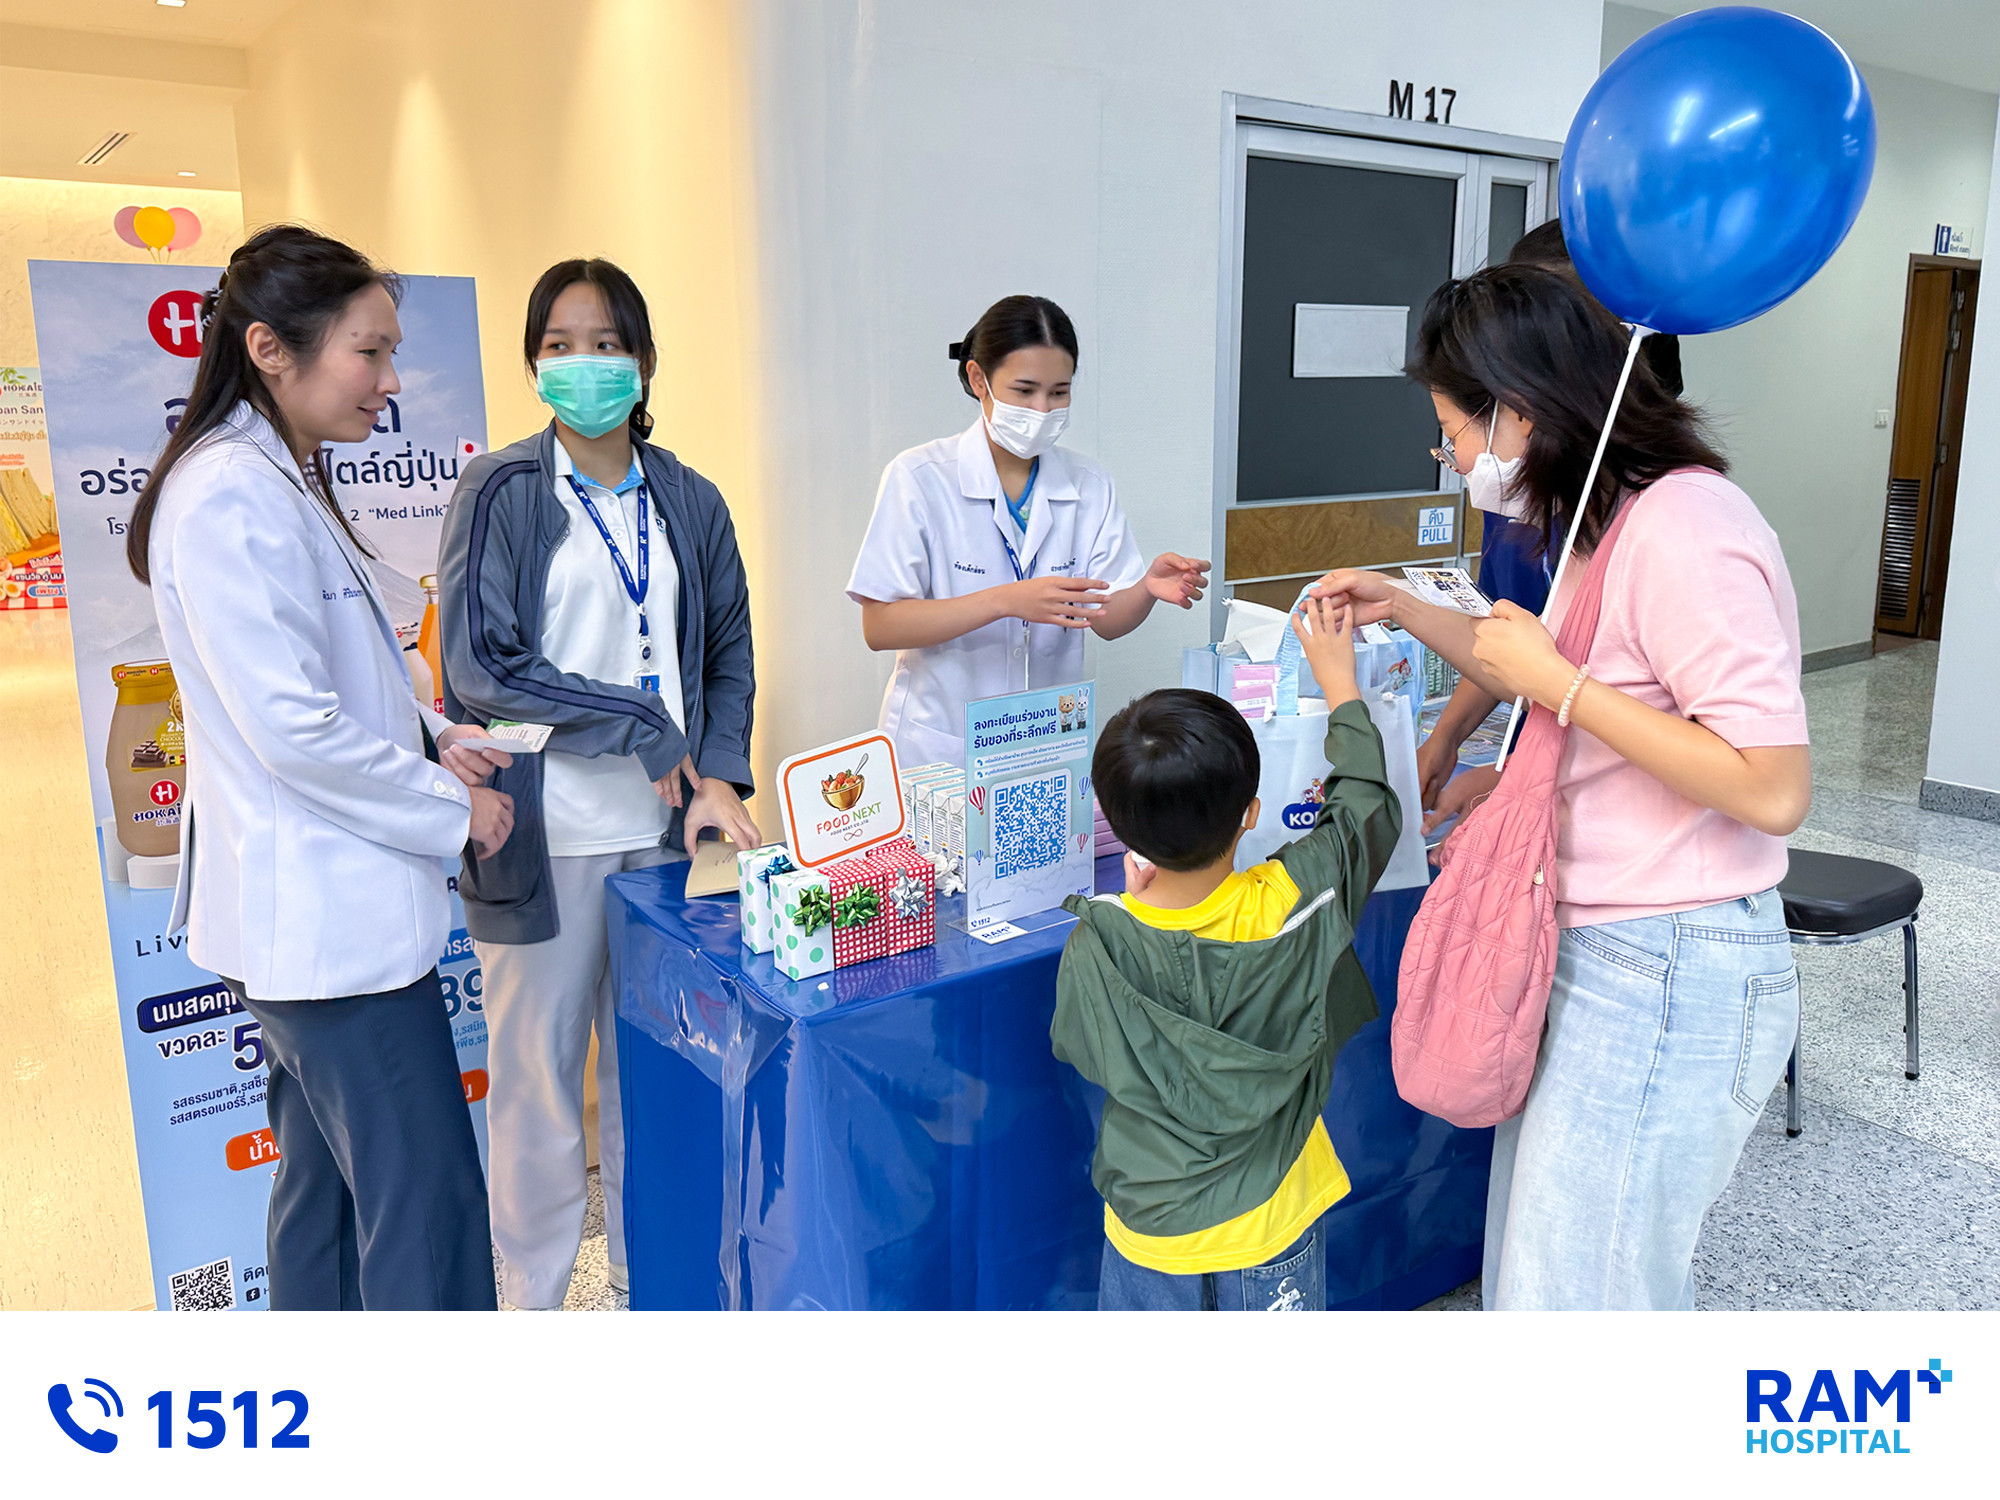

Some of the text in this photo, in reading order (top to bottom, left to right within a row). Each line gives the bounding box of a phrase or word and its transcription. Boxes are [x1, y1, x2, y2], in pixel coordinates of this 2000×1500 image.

[1388, 79, 1457, 125] M 17
[350, 509, 360, 521] 2
[1428, 508, 1445, 525] ดึง
[1421, 527, 1448, 543] PULL
[973, 707, 1057, 731] ลงทะเบียนร่วมงาน
[155, 783, 173, 802] H
[816, 801, 881, 835] FOOD NEXT
[158, 1021, 265, 1071] ขวดละ 5
